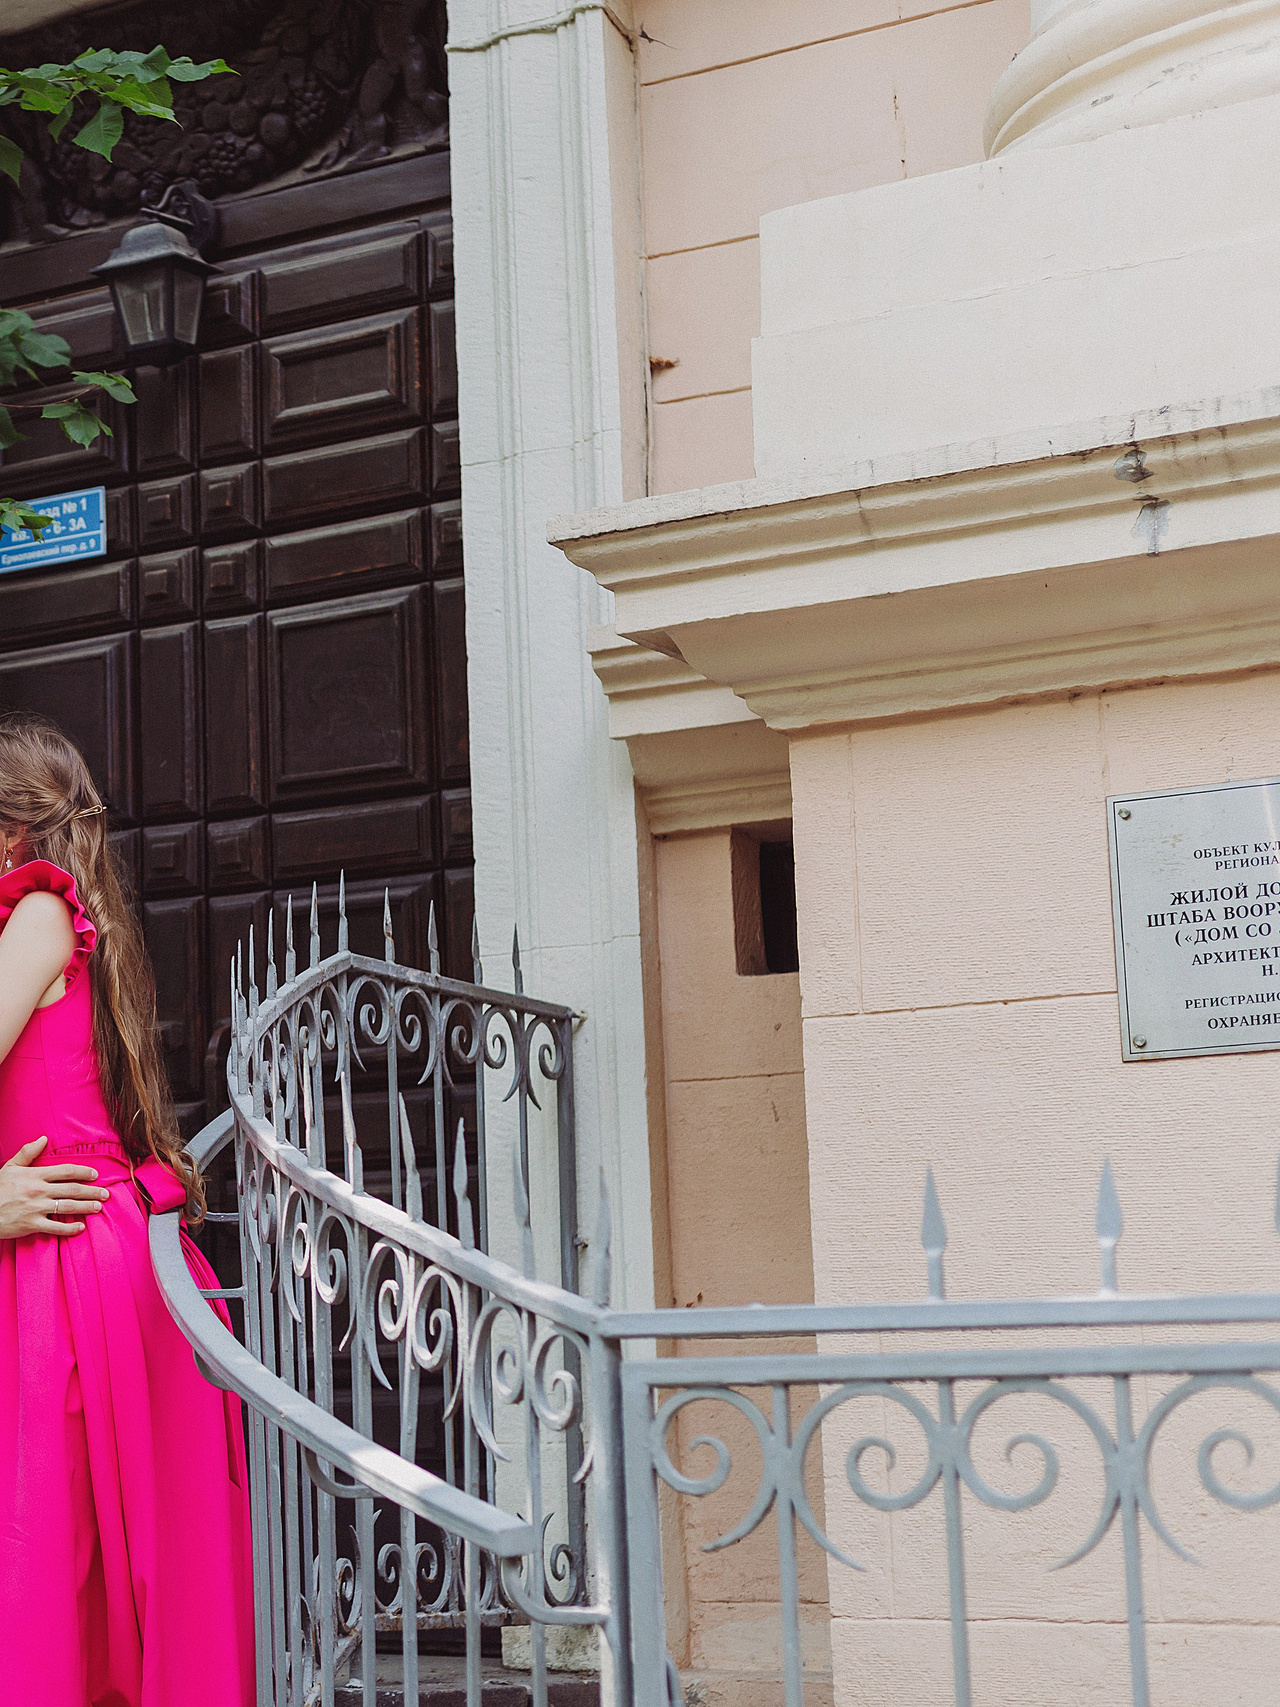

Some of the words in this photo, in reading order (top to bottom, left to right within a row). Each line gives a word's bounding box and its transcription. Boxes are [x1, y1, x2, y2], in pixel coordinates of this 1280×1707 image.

[62, 501, 78, 515] №
[79, 497, 87, 511] 1
[1193, 844, 1249, 860] ОБЪЕКТ
[1215, 855, 1280, 871] РЕГИОНА
[1170, 882, 1249, 906] ЖИЛОЙ
[1255, 881, 1280, 900] ДО
[1146, 908, 1217, 928] ШТАБА
[1245, 922, 1272, 938] СО
[1191, 946, 1280, 966] АРХИТЕКТ
[1261, 964, 1279, 977] Н.
